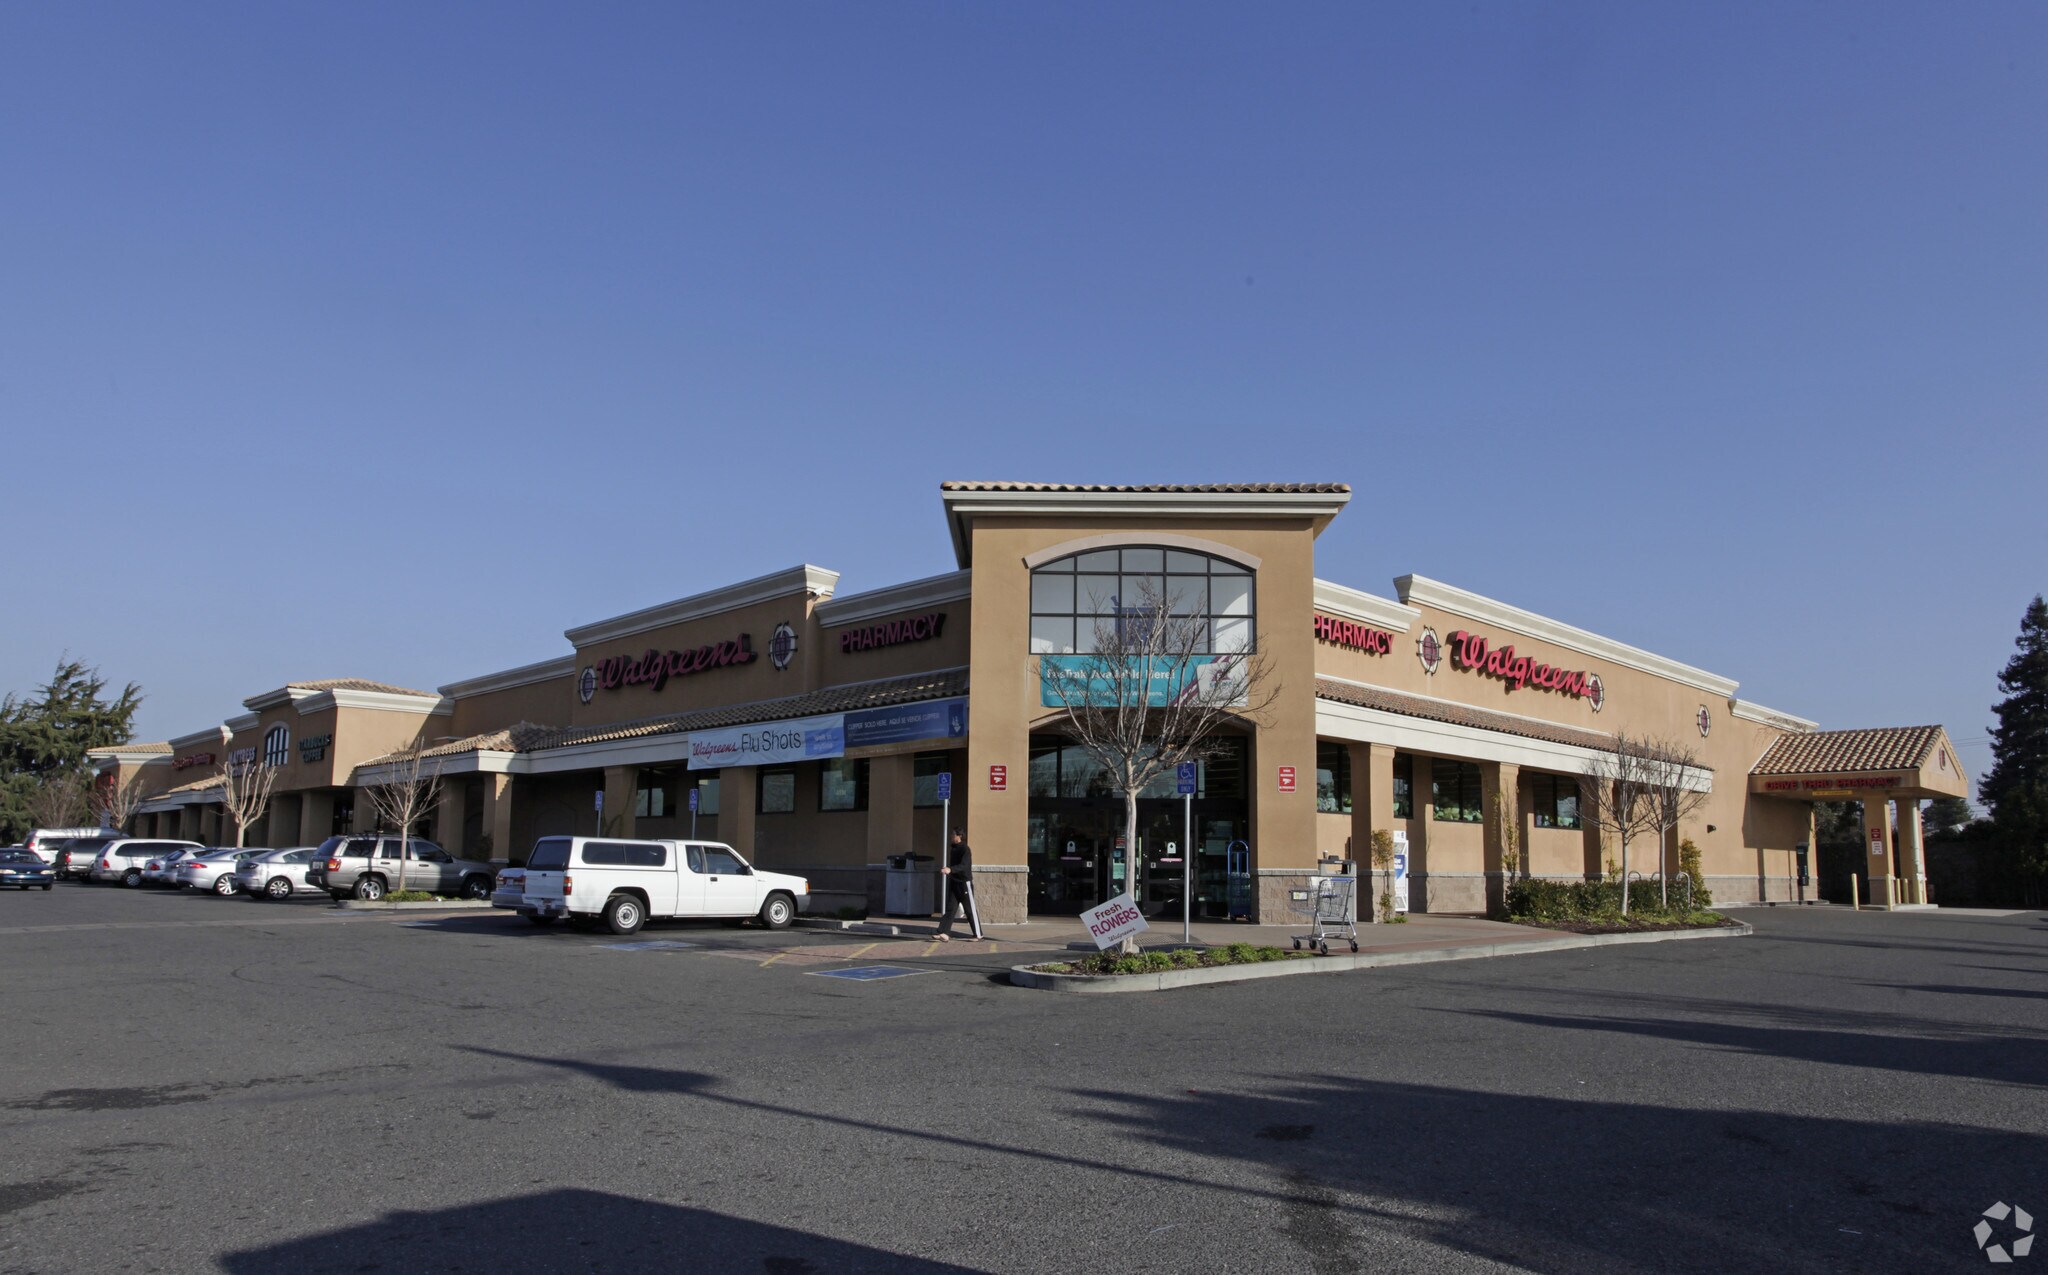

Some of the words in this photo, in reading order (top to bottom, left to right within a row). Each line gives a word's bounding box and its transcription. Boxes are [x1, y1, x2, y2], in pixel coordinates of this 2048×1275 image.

[840, 612, 943, 653] PHARMACY
[1314, 614, 1394, 655] PHARMACY
[597, 633, 752, 691] Walgreens
[1455, 629, 1592, 697] Walgreens
[228, 746, 257, 767] MATTRESS
[692, 741, 739, 759] Walgreens
[741, 733, 760, 753] Flu
[761, 730, 802, 752] Shots
[1765, 781, 1797, 791] DRIVE
[1801, 780, 1833, 789] THRU
[1837, 777, 1902, 788] PHARMACY
[1090, 907, 1139, 937] FLOWERS
[1094, 903, 1122, 921] Fresh
